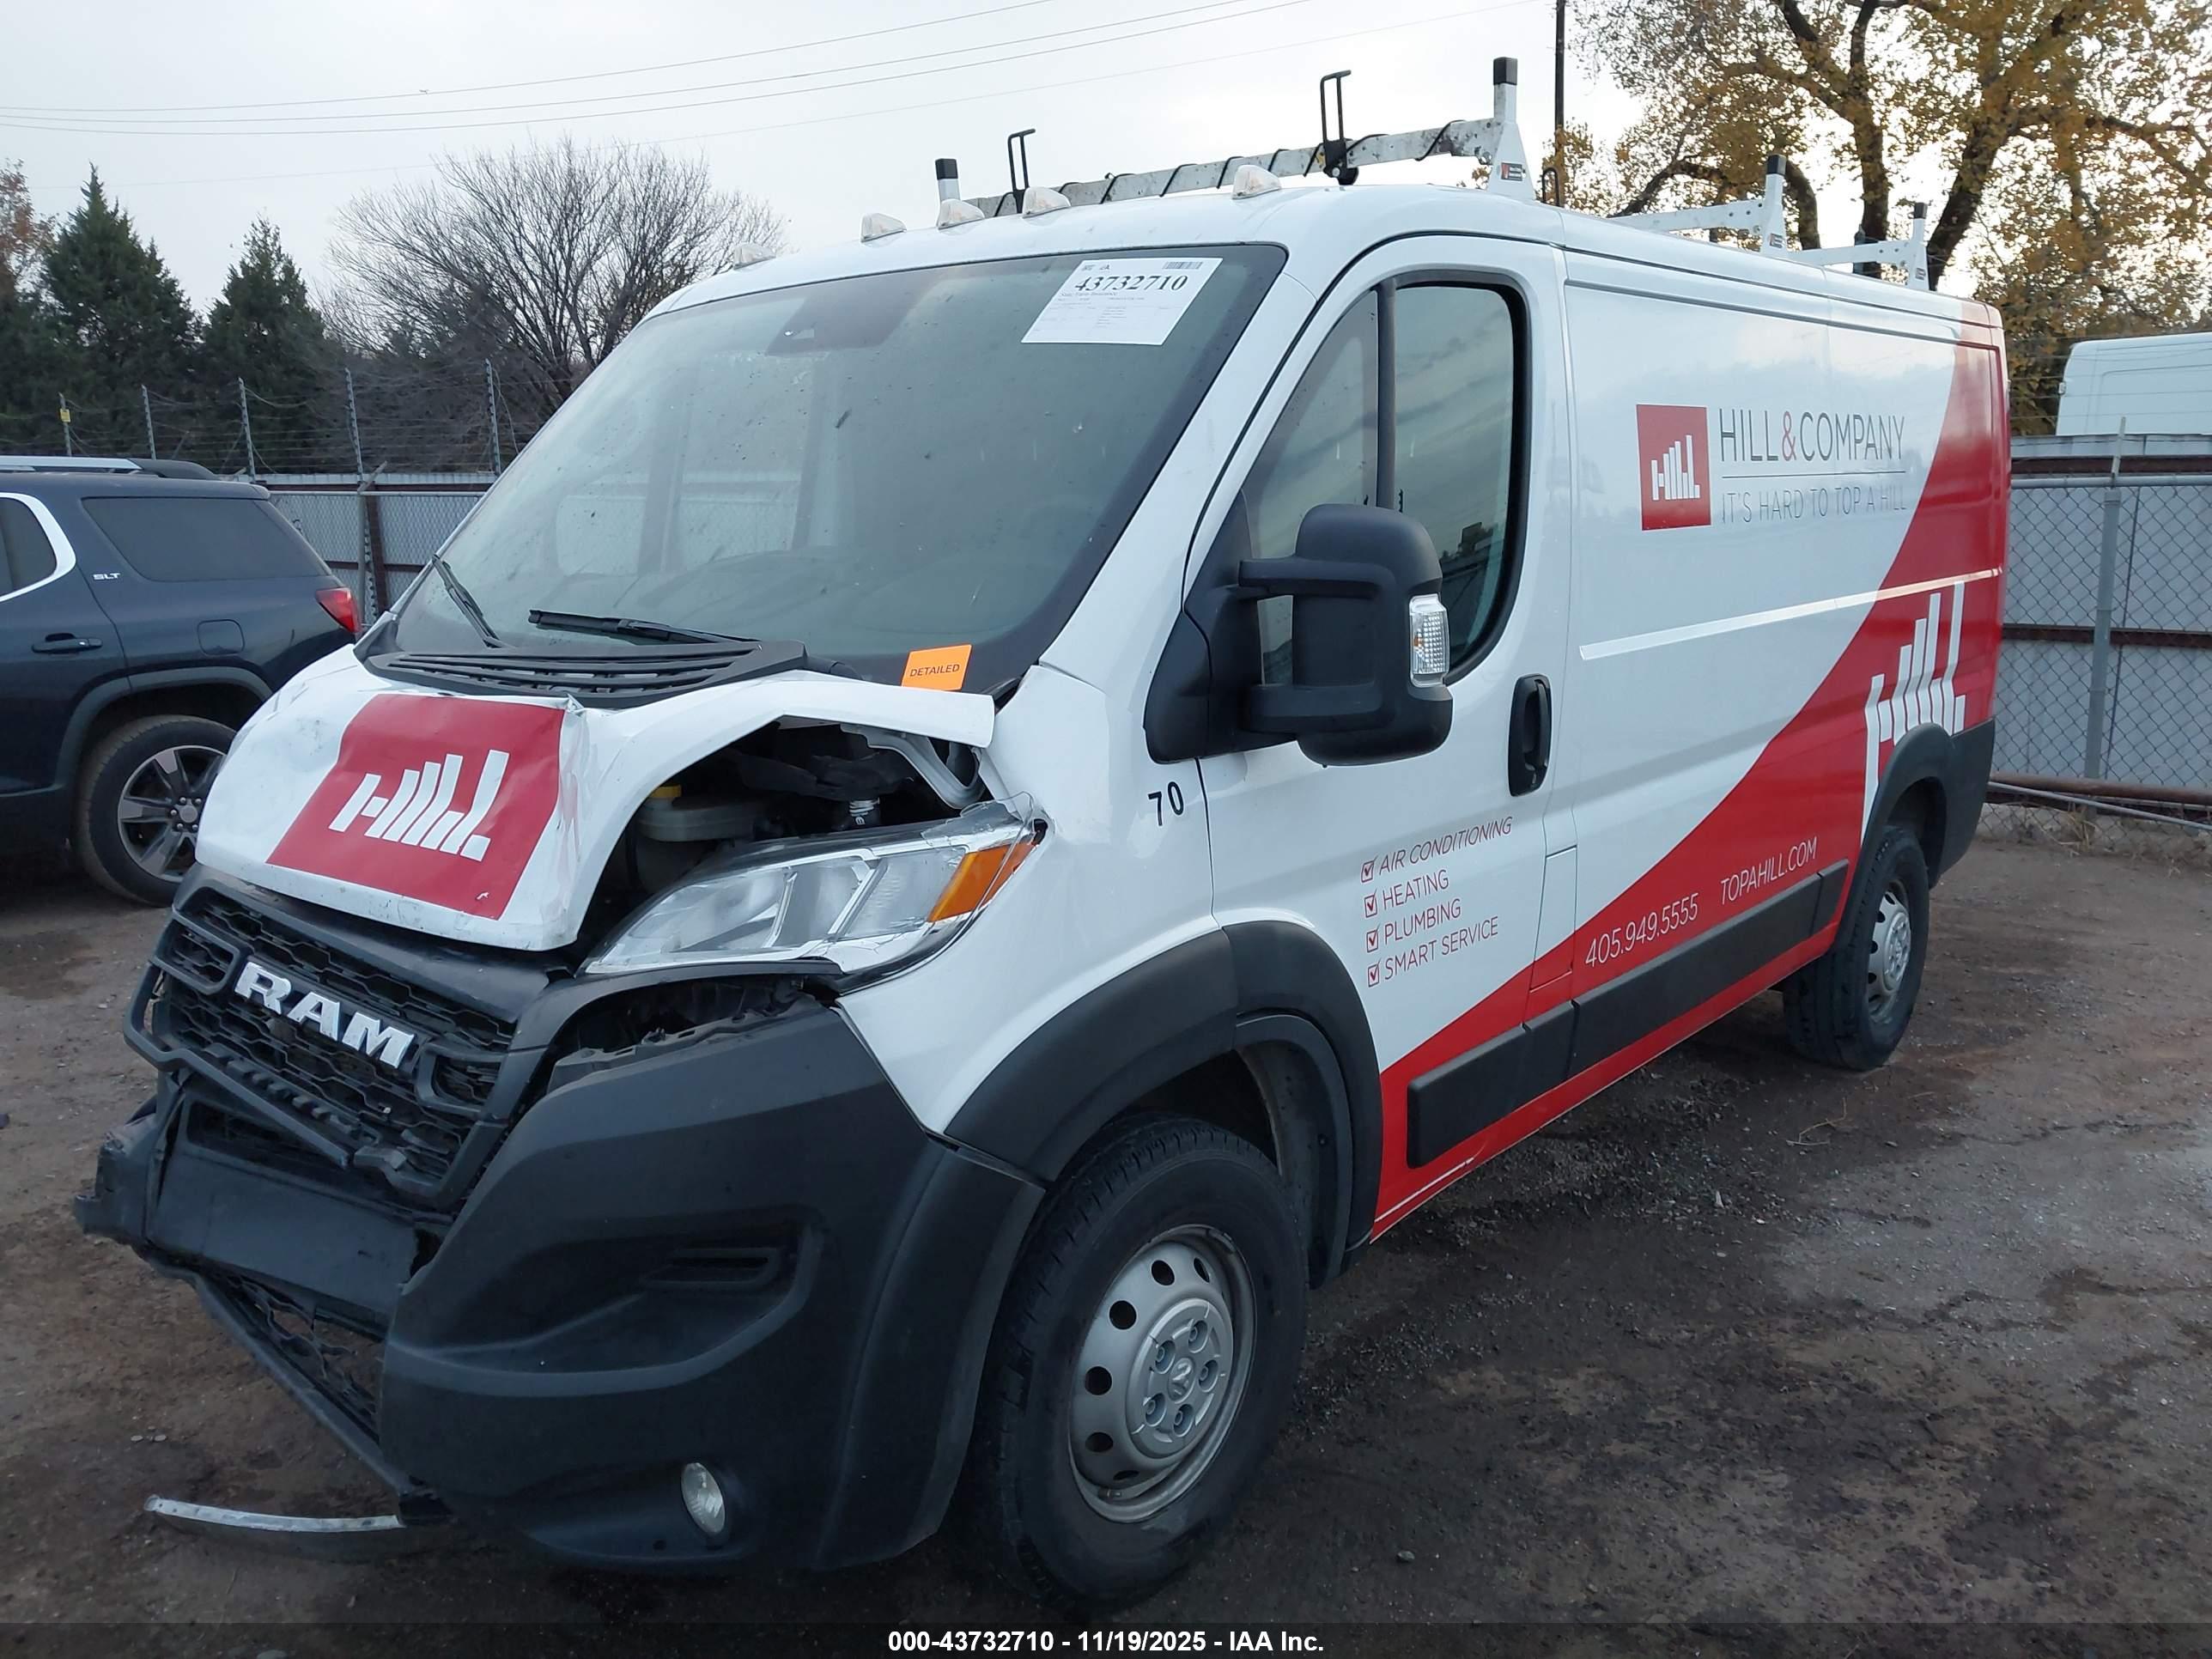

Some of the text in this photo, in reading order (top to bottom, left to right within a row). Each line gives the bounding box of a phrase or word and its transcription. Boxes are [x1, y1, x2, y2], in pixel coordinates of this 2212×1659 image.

[1075, 275, 1188, 291] 43732710
[1719, 408, 1905, 462] HILL&COMPANY
[1722, 484, 1908, 524] IT'S HARD TO TOP A HILL
[92, 572, 121, 580] SLT
[909, 663, 961, 678] DETAILED
[1147, 781, 1185, 827] 70
[1378, 816, 1513, 876] AIR CONDITIONING
[1382, 868, 1449, 911] HEATING
[1720, 836, 1818, 906] TOPAHILL.COM
[1383, 897, 1462, 945] PLUMBING
[1584, 892, 1699, 968] 405.949.5555
[1383, 915, 1499, 981] SMART SERVICE
[234, 961, 416, 1070] RAM
